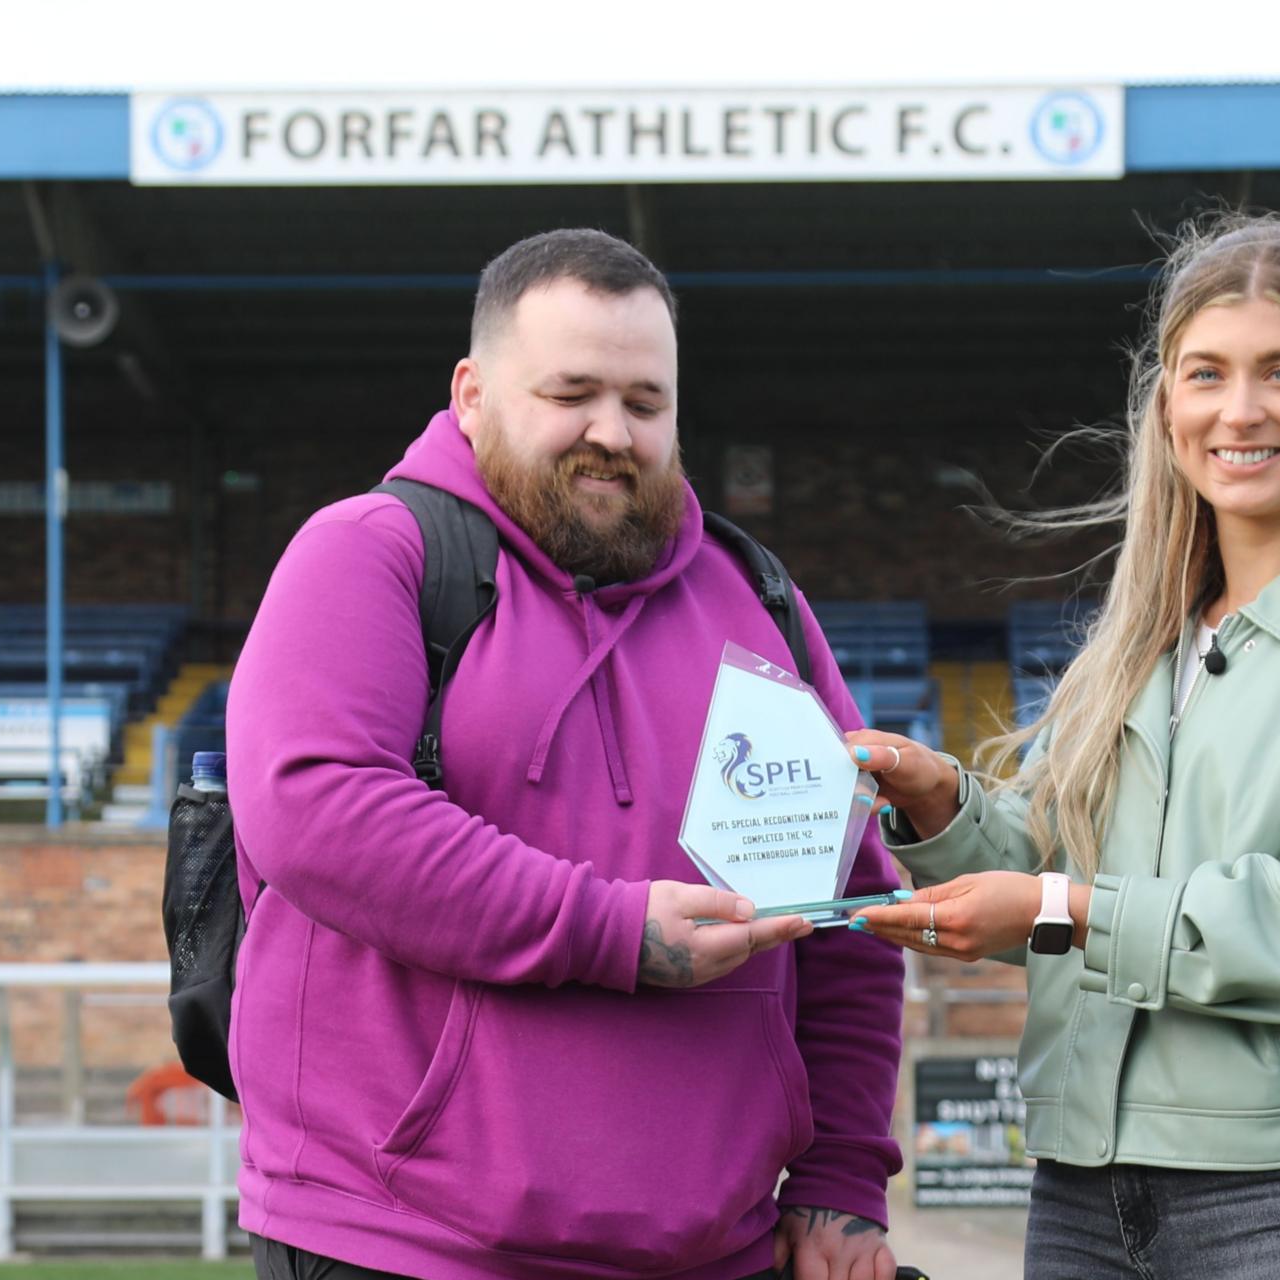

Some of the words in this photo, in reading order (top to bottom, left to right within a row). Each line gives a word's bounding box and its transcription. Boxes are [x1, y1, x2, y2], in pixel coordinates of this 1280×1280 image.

[240, 109, 510, 161] FORFAR
[536, 105, 869, 161] ATHLETIC
[895, 103, 1013, 156] F.C.
[746, 758, 822, 787] SPFL
[711, 821, 729, 831] SPFL
[731, 817, 761, 829] SPECIAL
[764, 813, 810, 826] RECOGNITION
[813, 810, 839, 820] AWARD
[742, 832, 784, 845] COMPLETED
[786, 831, 800, 840] THE
[726, 854, 740, 864] JON
[743, 848, 799, 862] ATTENBOROUGH
[801, 847, 817, 856] AND
[819, 845, 834, 855] SAM
